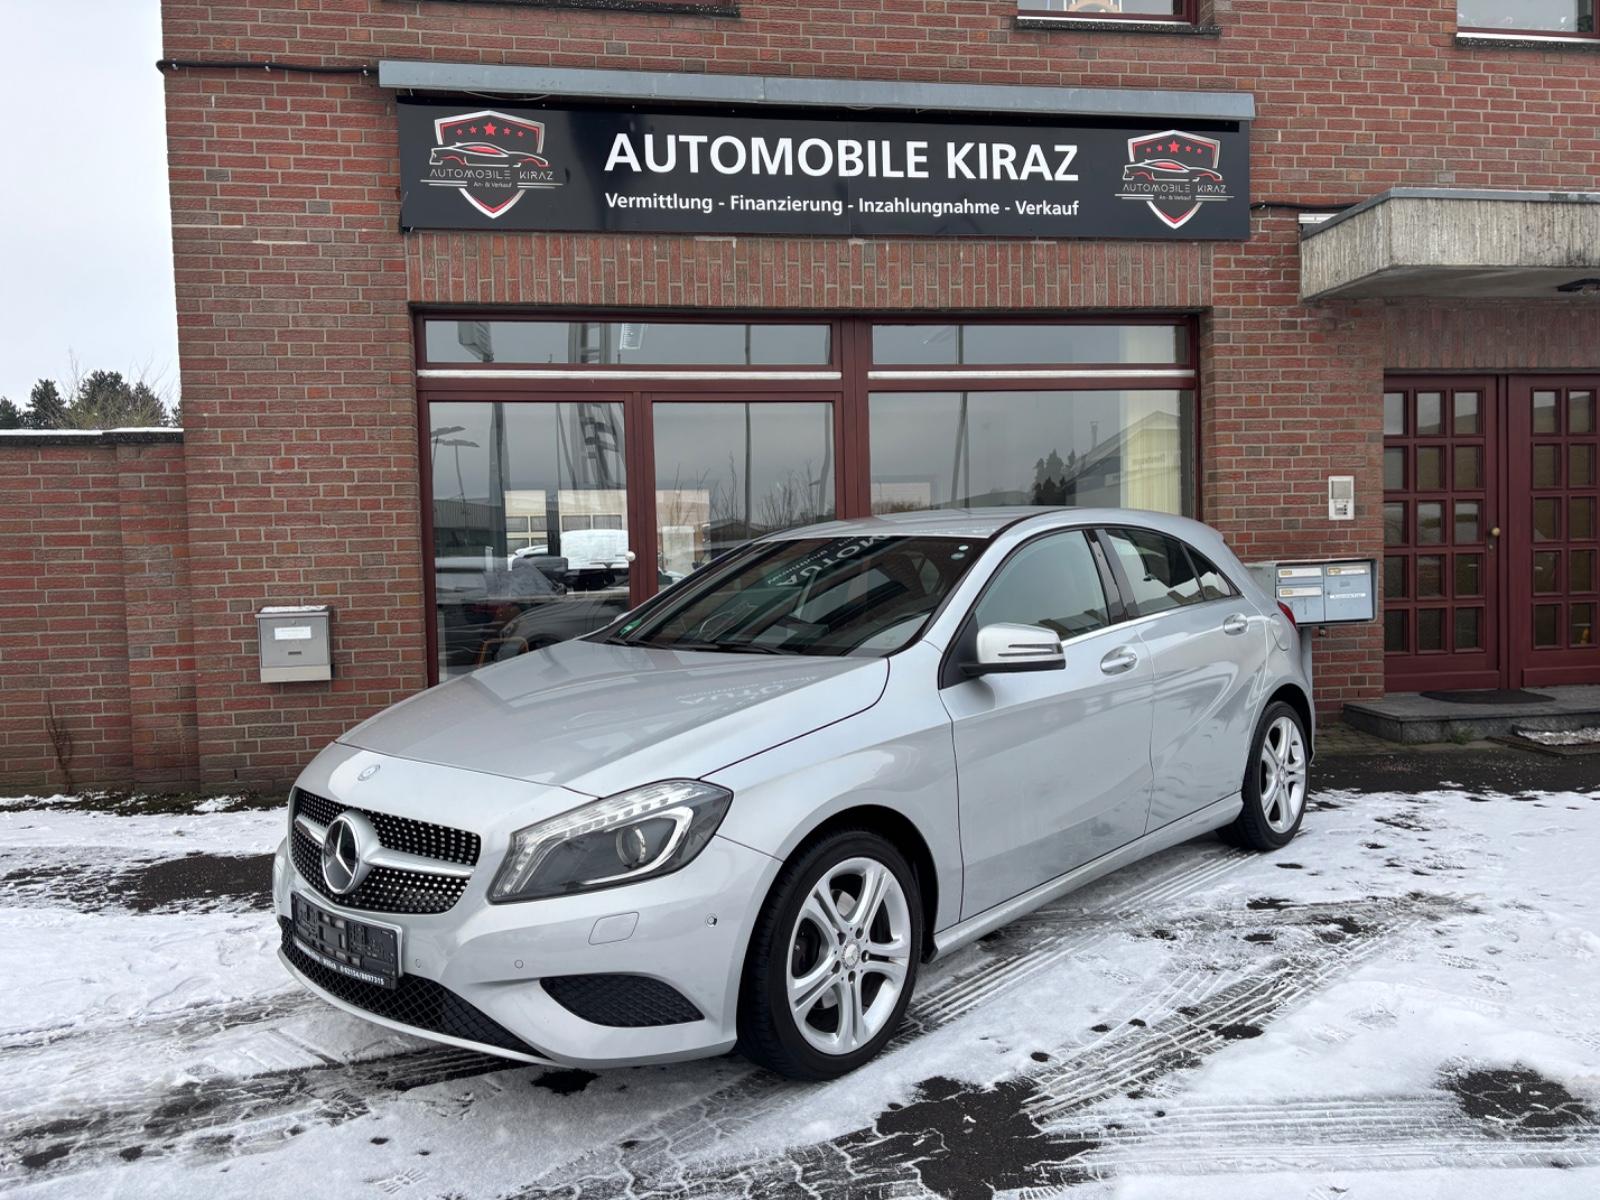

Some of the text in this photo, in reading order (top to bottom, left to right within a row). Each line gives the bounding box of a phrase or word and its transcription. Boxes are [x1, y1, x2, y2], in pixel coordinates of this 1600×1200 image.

[604, 132, 1080, 183] AUTOMOBILE KIRAZ
[429, 168, 554, 180] AUTOMOBILE KIRAZ
[1122, 183, 1227, 194] AUTOMOBILE KIRAZ
[604, 192, 713, 214] Vermittlung
[730, 194, 843, 217] Finanzierung
[858, 196, 1001, 219] Inzahlungnahme
[1014, 199, 1080, 216] Verkauf
